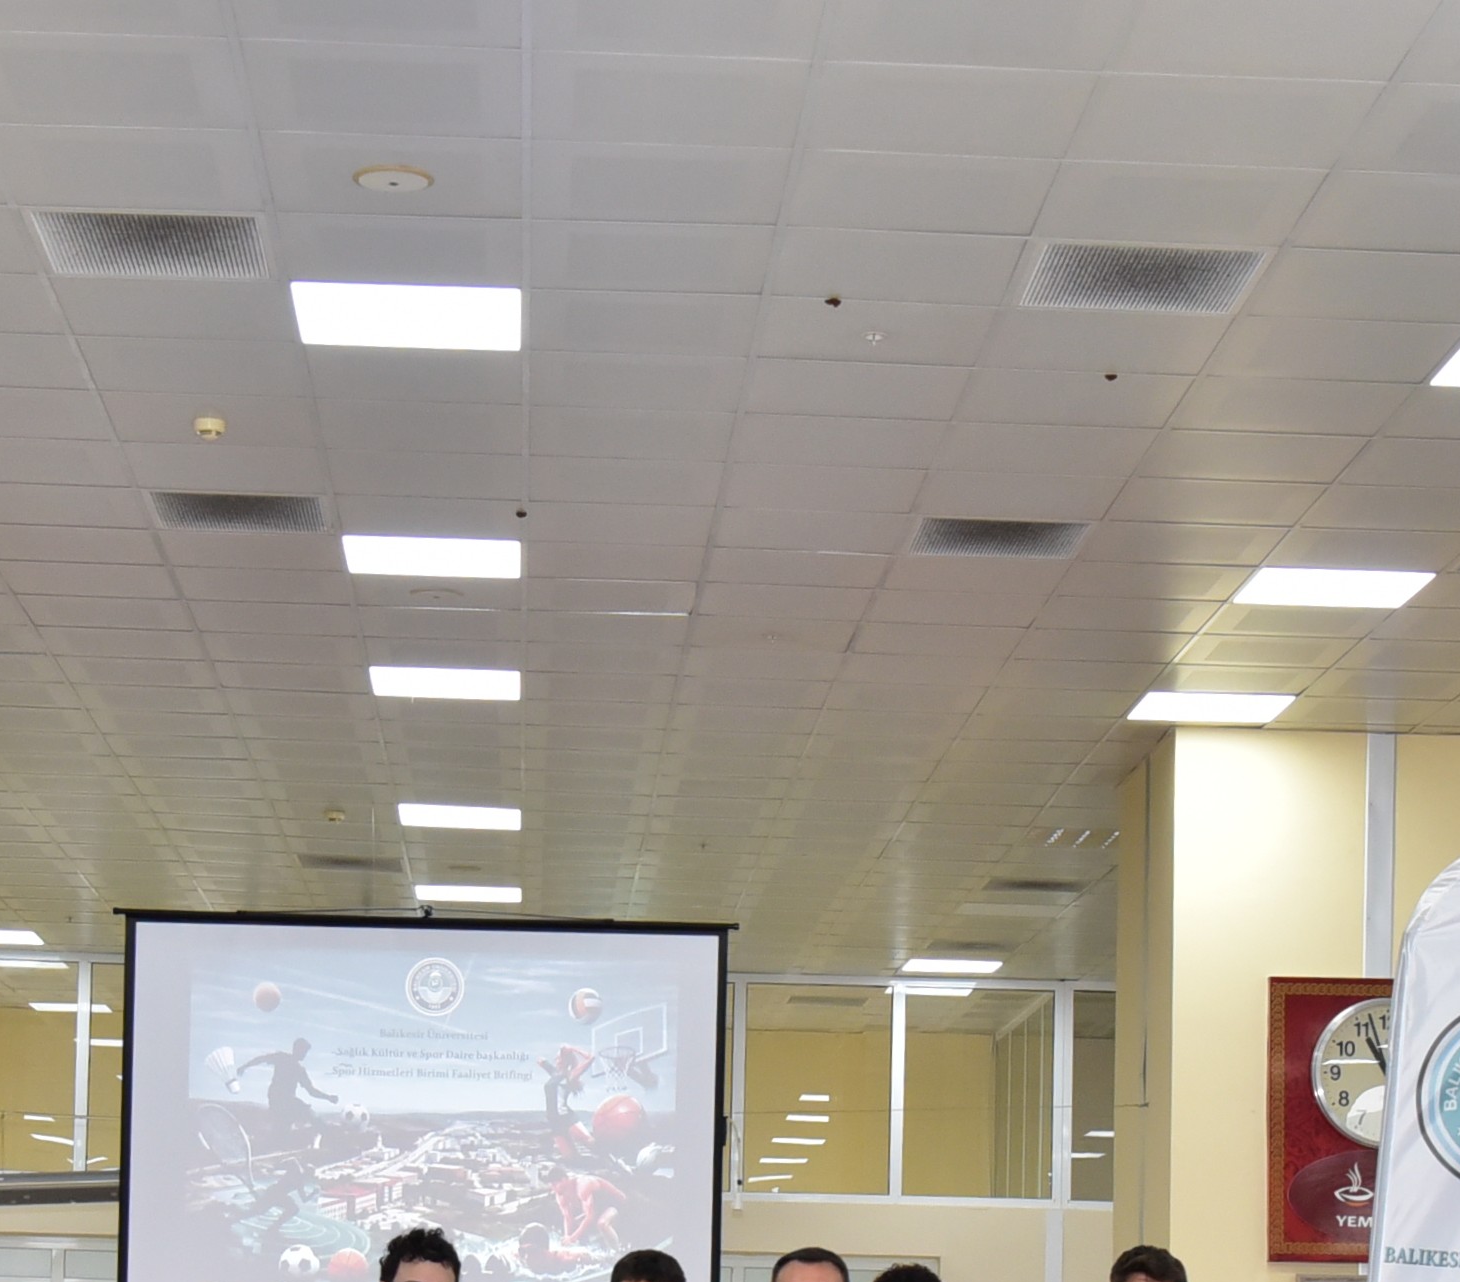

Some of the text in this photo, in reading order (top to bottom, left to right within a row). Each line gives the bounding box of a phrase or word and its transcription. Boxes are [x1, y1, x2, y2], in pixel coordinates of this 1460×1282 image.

[1335, 1041, 1356, 1057] 10
[1329, 1064, 1341, 1081] 9
[1338, 1090, 1350, 1107] 8
